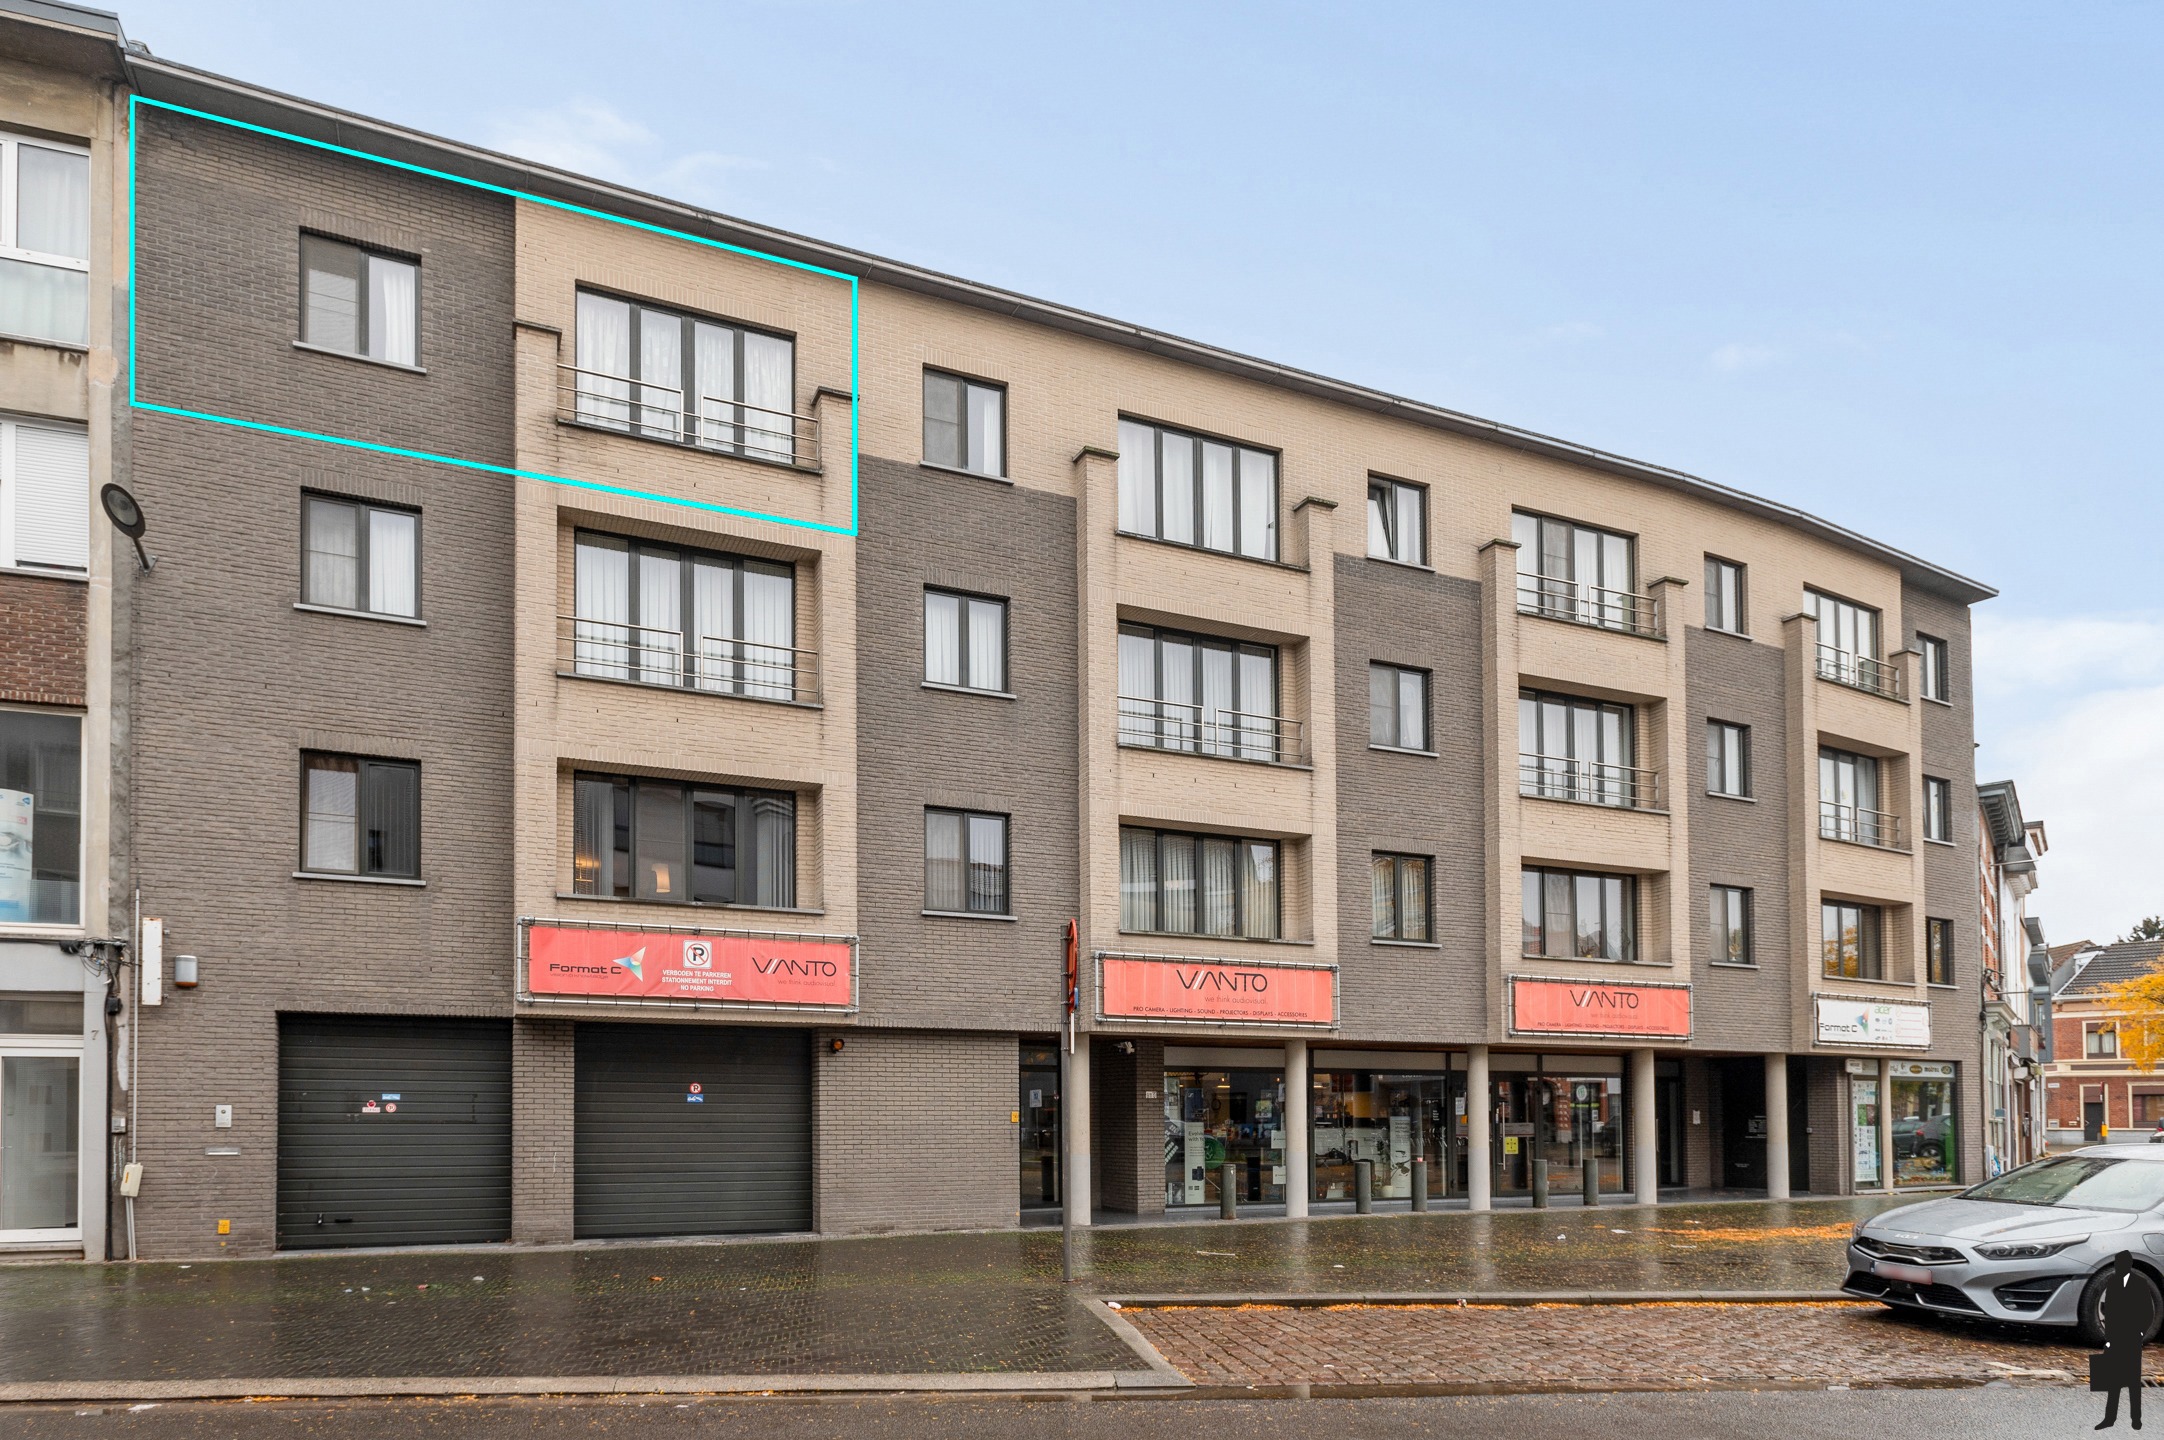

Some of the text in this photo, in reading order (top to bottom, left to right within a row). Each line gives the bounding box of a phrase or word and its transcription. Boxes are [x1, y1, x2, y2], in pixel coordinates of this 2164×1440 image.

[549, 963, 622, 975] Format C
[662, 969, 693, 977] VERBODEN
[702, 971, 732, 979] PARKEREN
[661, 976, 707, 985] STATIONNEMENT
[1216, 994, 1230, 1003] think
[1874, 1005, 1892, 1014] acer
[1819, 1022, 1858, 1033] Format C
